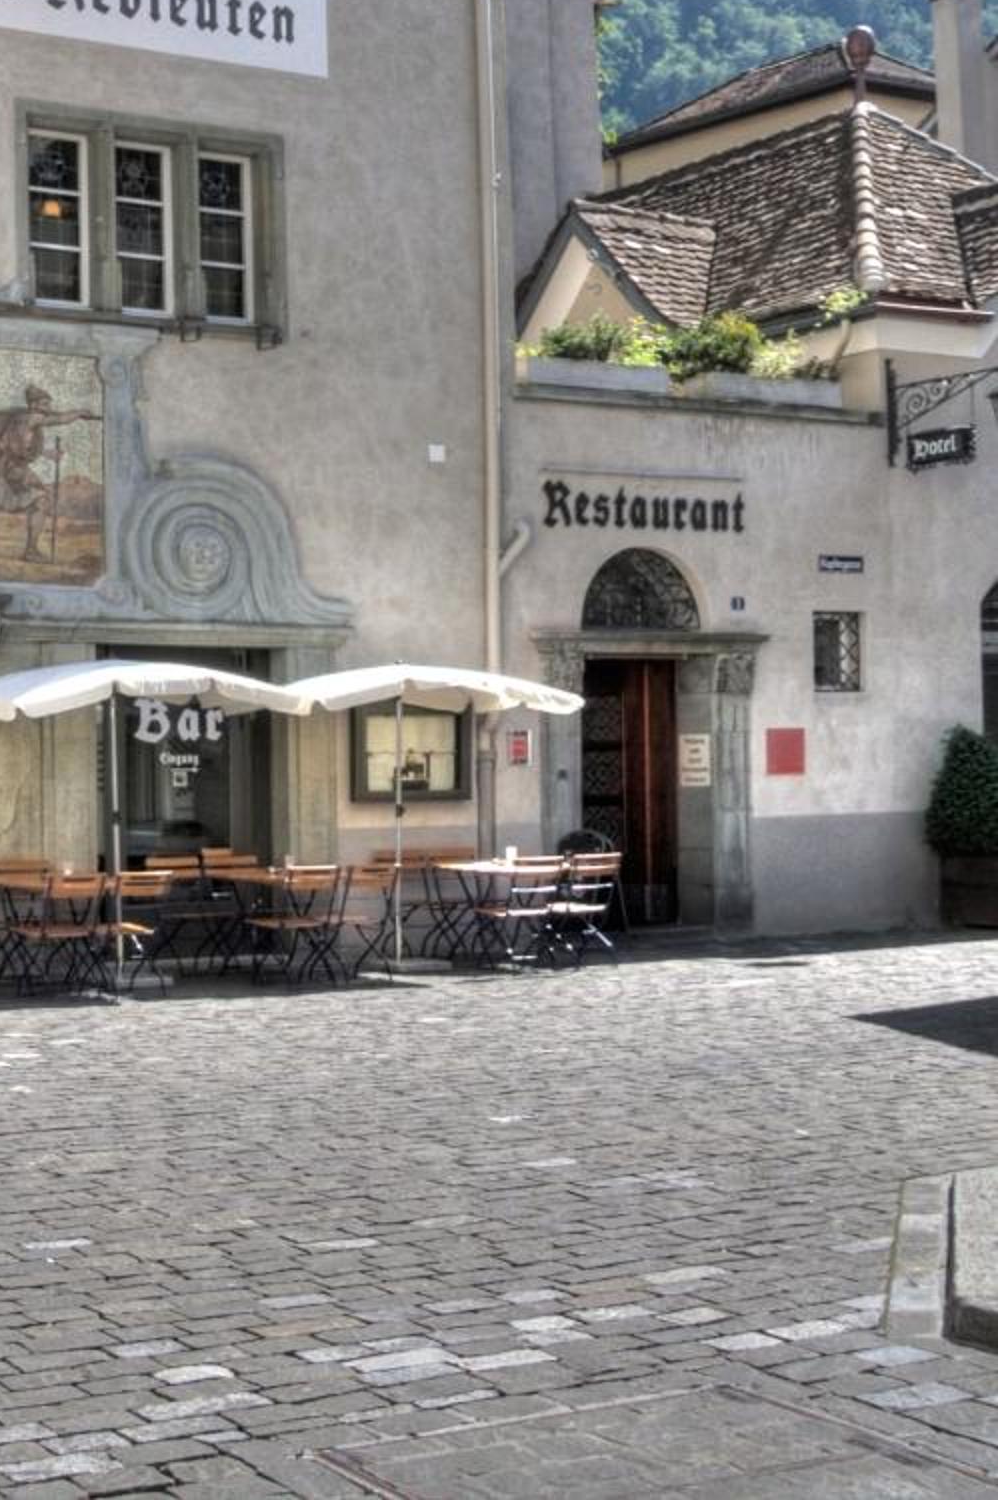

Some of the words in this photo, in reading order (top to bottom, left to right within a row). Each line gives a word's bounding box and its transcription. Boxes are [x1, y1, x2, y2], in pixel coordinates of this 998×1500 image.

[913, 433, 957, 461] Hotel
[542, 479, 746, 533] Restaurant
[134, 699, 224, 743] Bar
